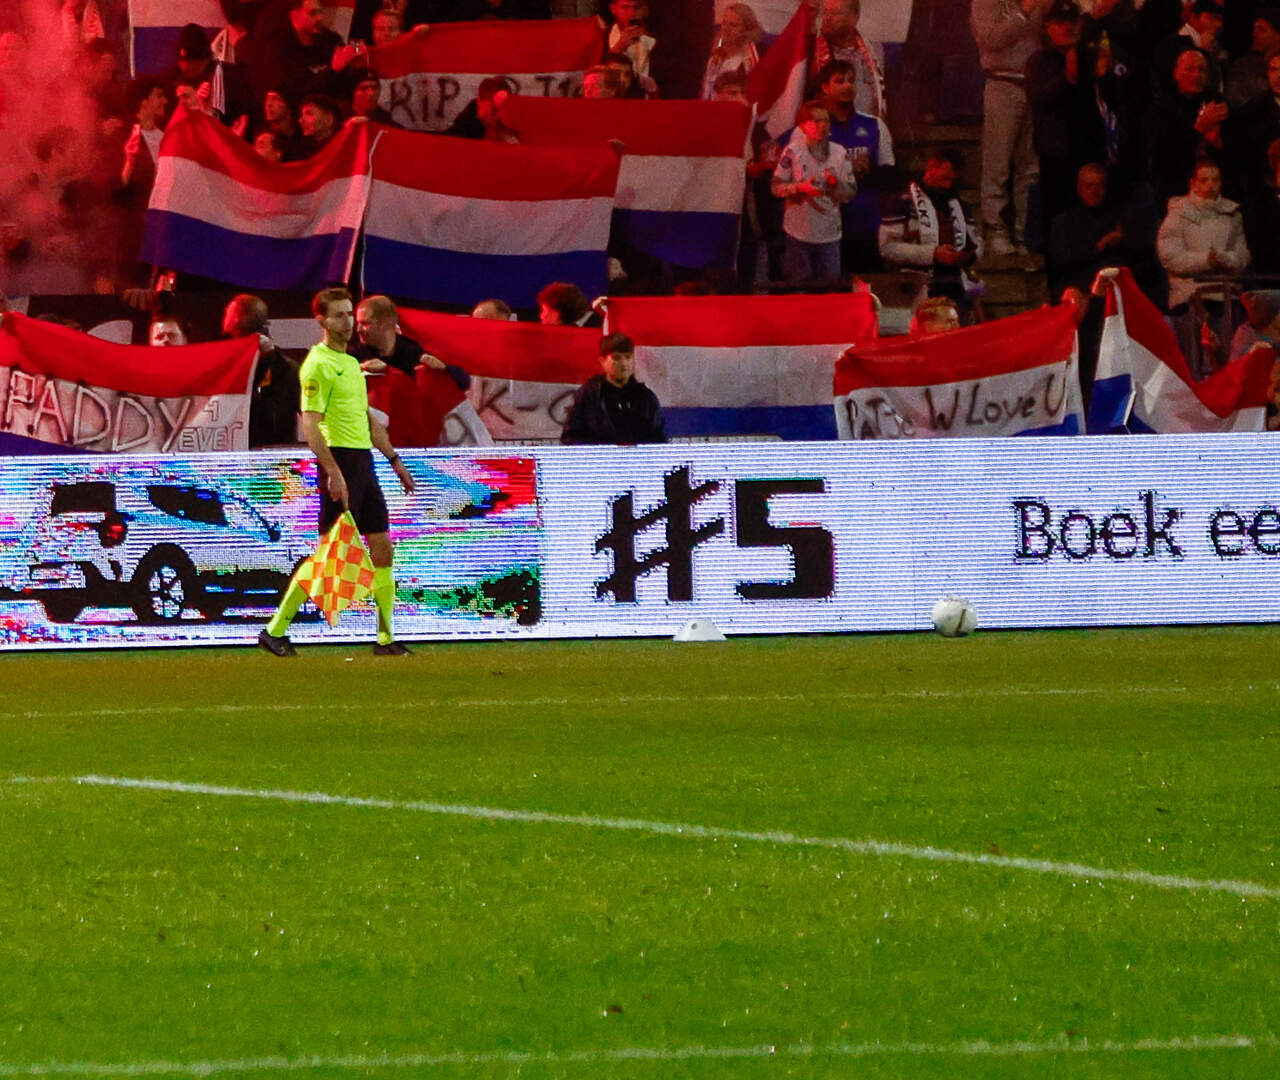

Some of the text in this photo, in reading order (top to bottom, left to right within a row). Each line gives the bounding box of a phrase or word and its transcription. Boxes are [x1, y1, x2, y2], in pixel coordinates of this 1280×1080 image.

[5, 369, 192, 453] PADDY
[590, 460, 838, 604] #5
[1010, 487, 1185, 563] Boek
